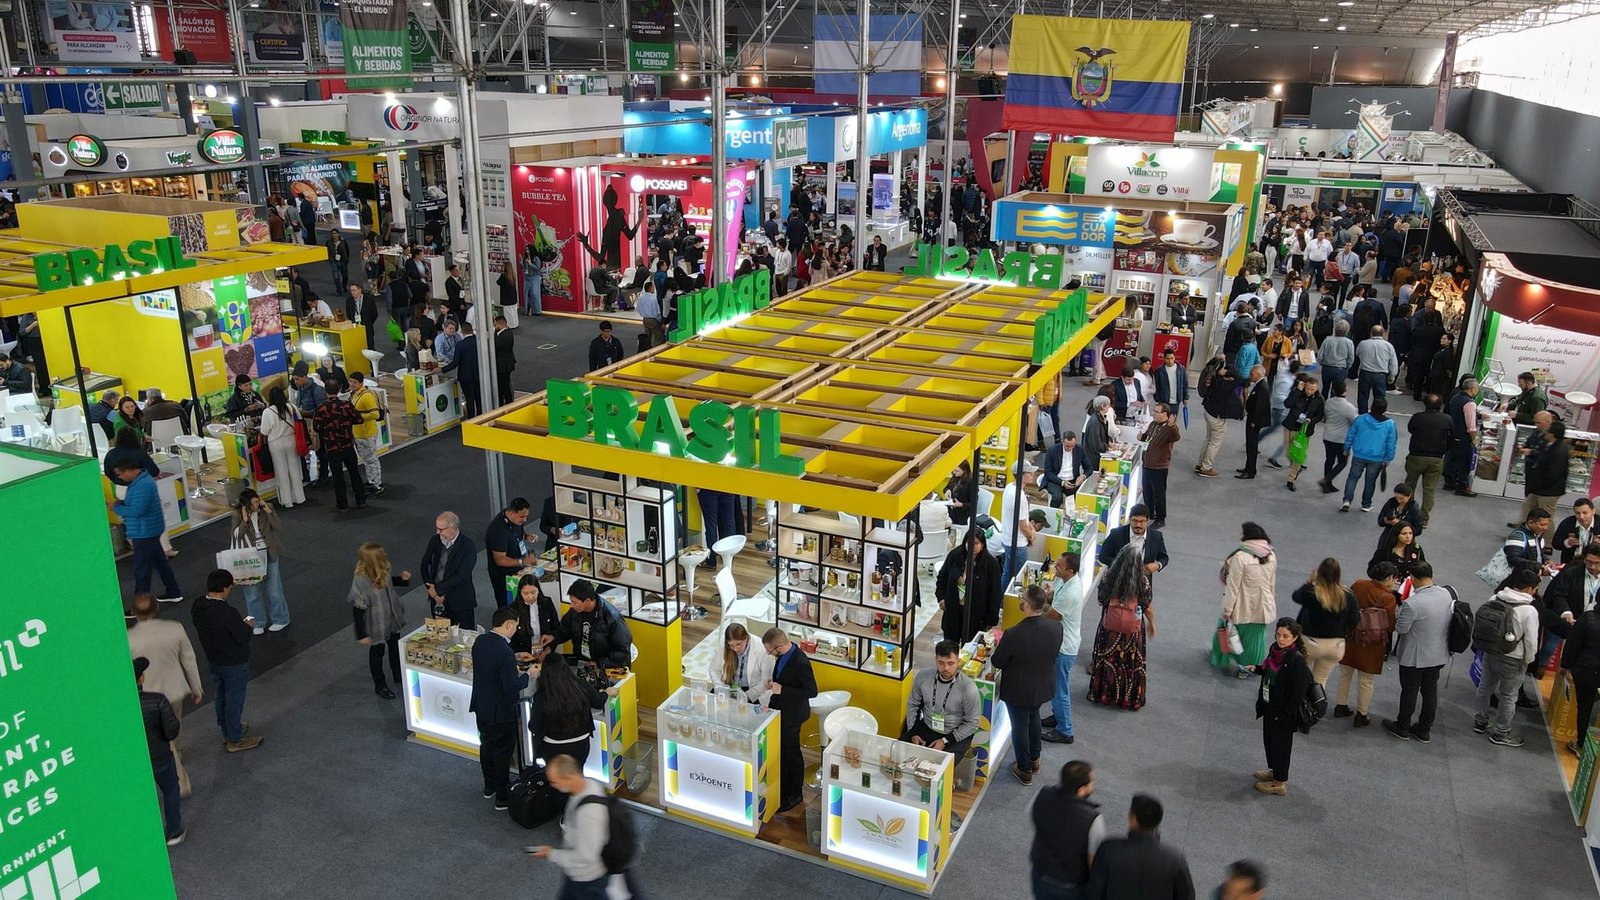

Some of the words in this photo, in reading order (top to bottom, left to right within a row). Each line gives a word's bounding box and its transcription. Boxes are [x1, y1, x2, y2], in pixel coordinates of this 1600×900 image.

[204, 18, 215, 26] DE
[168, 25, 216, 33] INOVACIÓN
[352, 45, 403, 57] ALIMENTOS
[635, 50, 670, 59] ALIMENTOS
[355, 60, 362, 71] Y
[364, 60, 402, 71] BEBIDAS
[642, 58, 668, 66] BEBIDAS
[123, 84, 159, 104] SALIDA
[400, 114, 432, 123] ORGINOR
[432, 116, 460, 124] NATURA
[891, 121, 921, 141] Argentina
[214, 134, 237, 146] Villa
[786, 126, 807, 151] SALIDA
[74, 139, 91, 150] Villa
[73, 148, 97, 159] Natura
[210, 145, 243, 157] Natura
[311, 162, 342, 173] ALIMENTO
[1126, 166, 1168, 179] Villacorp
[645, 179, 688, 190] POSSMEI
[521, 192, 551, 201] BUBBLE
[551, 193, 567, 202] TEA
[1082, 222, 1107, 233] CUA
[1081, 231, 1106, 242] DOR
[1094, 252, 1112, 260] MÜLLER
[32, 236, 197, 293] BRASIL
[1553, 337, 1597, 348] endulzando
[1540, 347, 1562, 355] desde
[1562, 348, 1581, 357] hace
[546, 378, 806, 477] BRASIL
[233, 558, 261, 567] BRASIL
[0, 733, 51, 772] NT,
[689, 772, 732, 790] EXPOENTE
[0, 828, 67, 879] RNMENT
